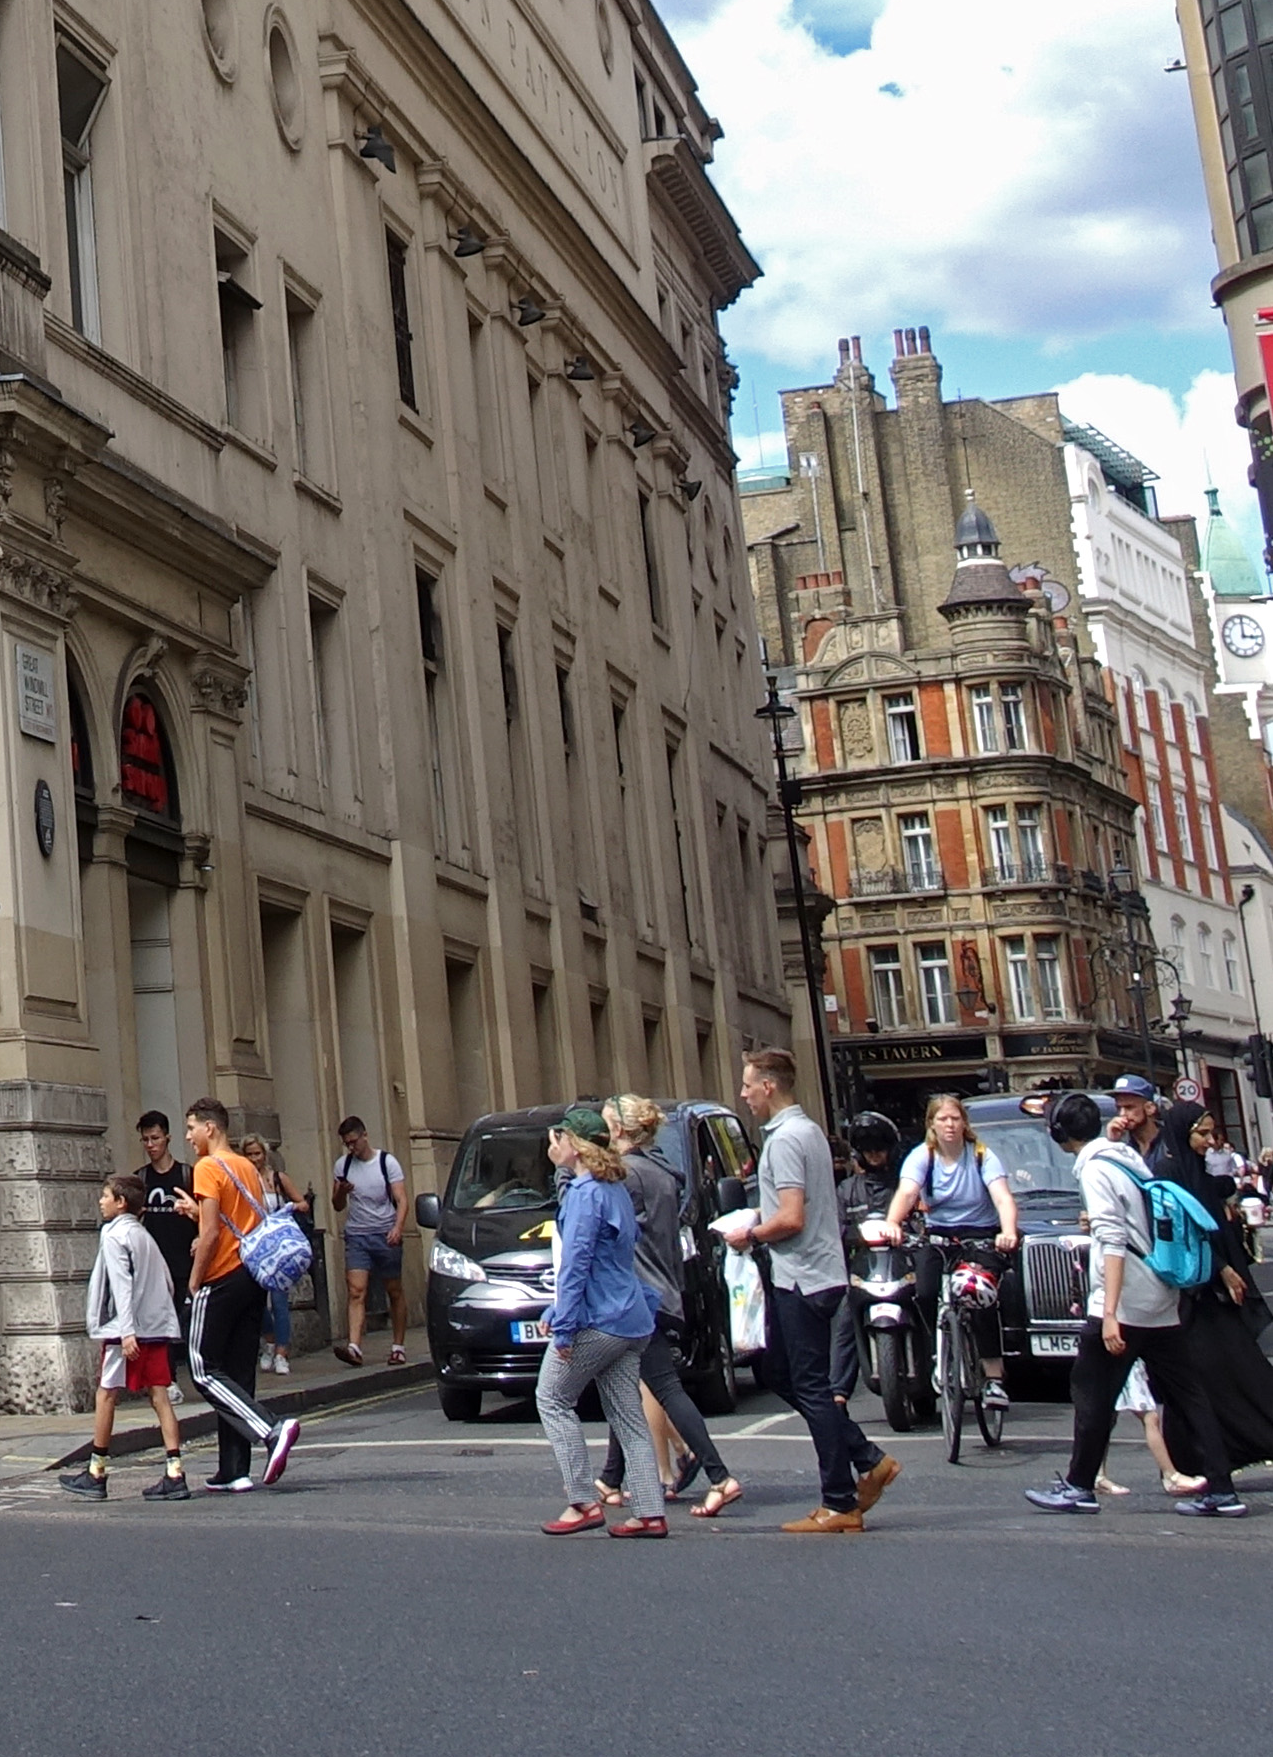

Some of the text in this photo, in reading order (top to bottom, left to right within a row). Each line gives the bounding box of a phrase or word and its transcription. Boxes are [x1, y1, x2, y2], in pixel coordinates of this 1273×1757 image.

[506, 18, 619, 210] PAVILION
[881, 1045, 943, 1060] TAVERN
[1179, 1085, 1196, 1095] 20
